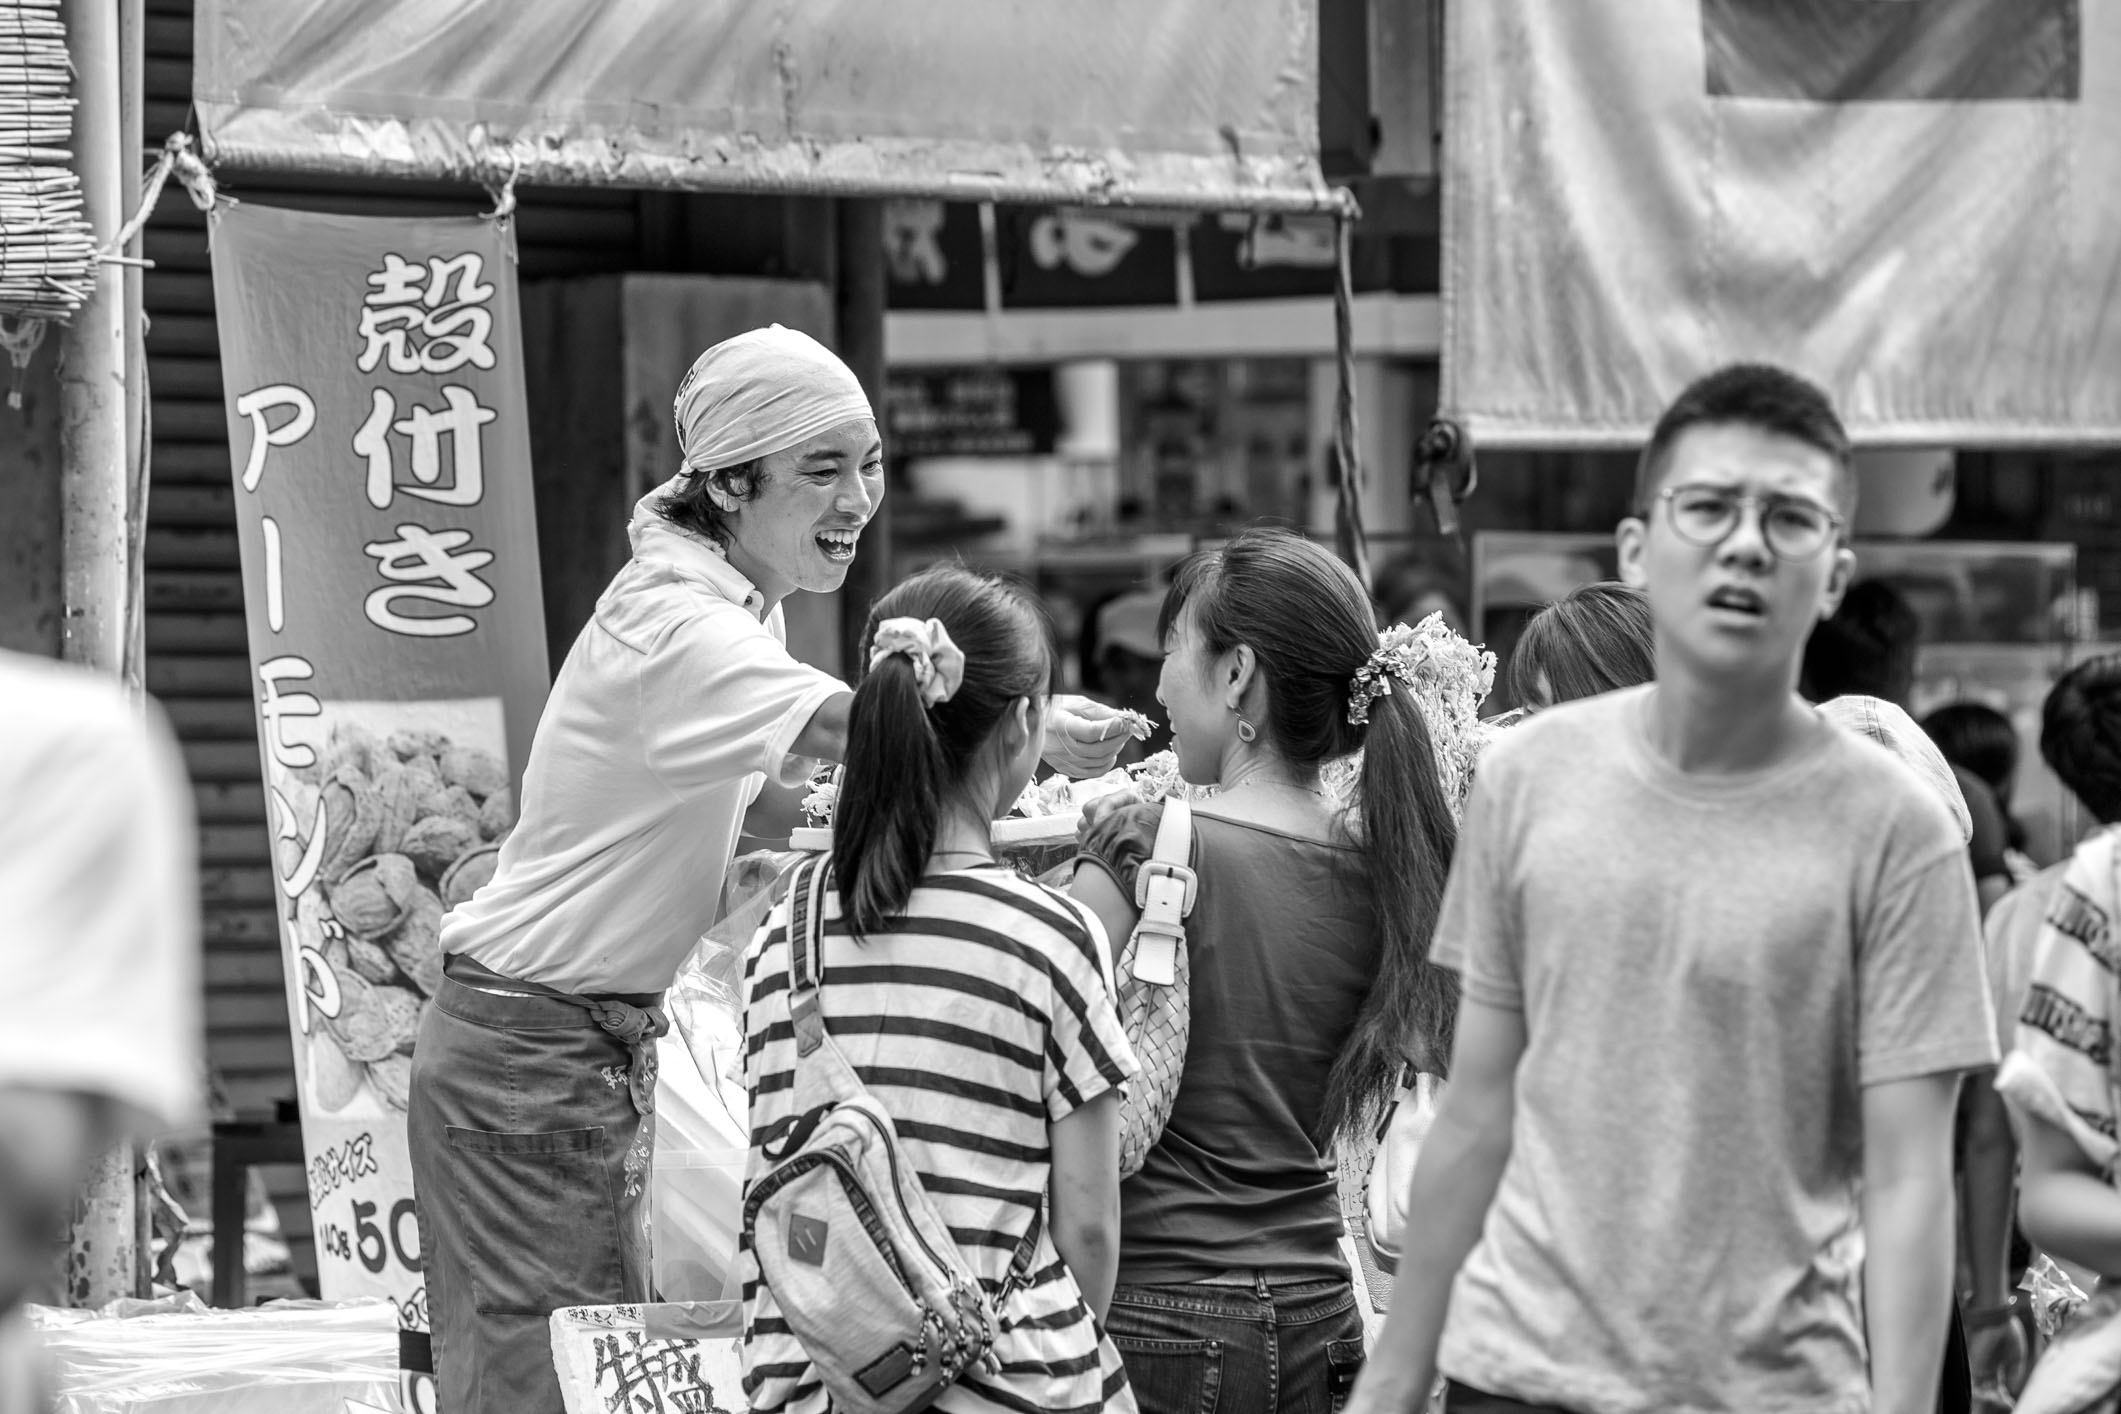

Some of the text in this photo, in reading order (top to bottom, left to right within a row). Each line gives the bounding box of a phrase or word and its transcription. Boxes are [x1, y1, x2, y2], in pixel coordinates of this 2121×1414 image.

[354, 252, 498, 637] 殻付き
[237, 384, 344, 1035] アーモンド
